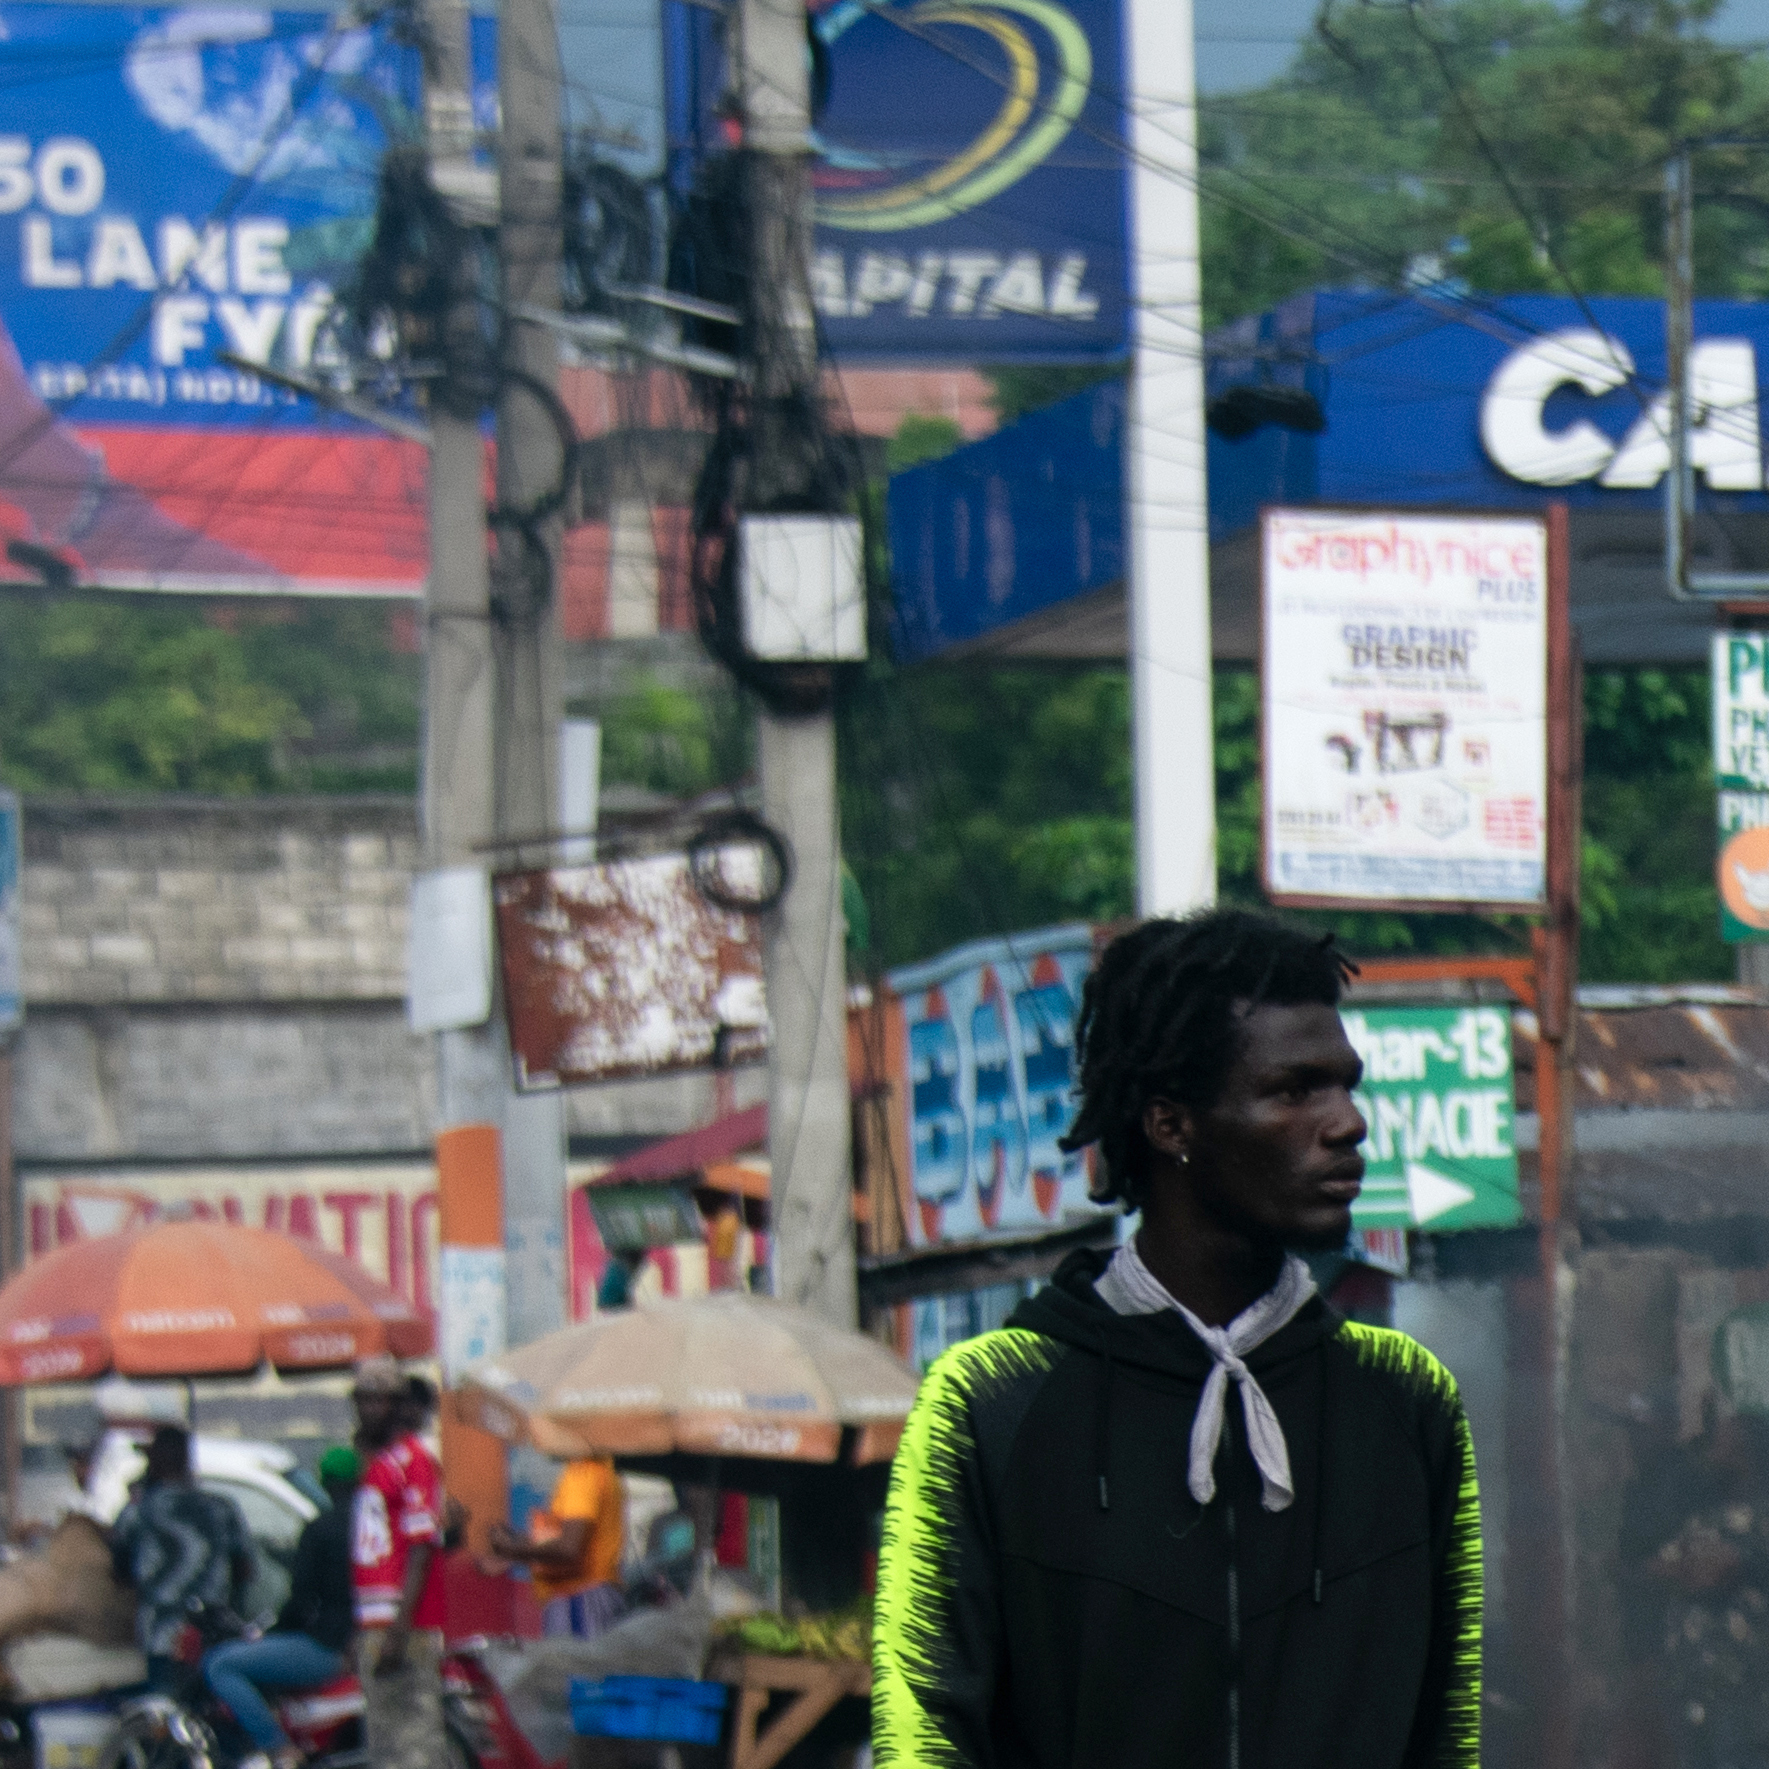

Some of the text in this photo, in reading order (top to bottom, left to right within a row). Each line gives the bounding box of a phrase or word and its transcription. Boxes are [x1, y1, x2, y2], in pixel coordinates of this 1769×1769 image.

[809, 250, 1100, 321] APITAL
[1342, 622, 1479, 650] GRAPHIC
[1351, 645, 1470, 672] DESIGN
